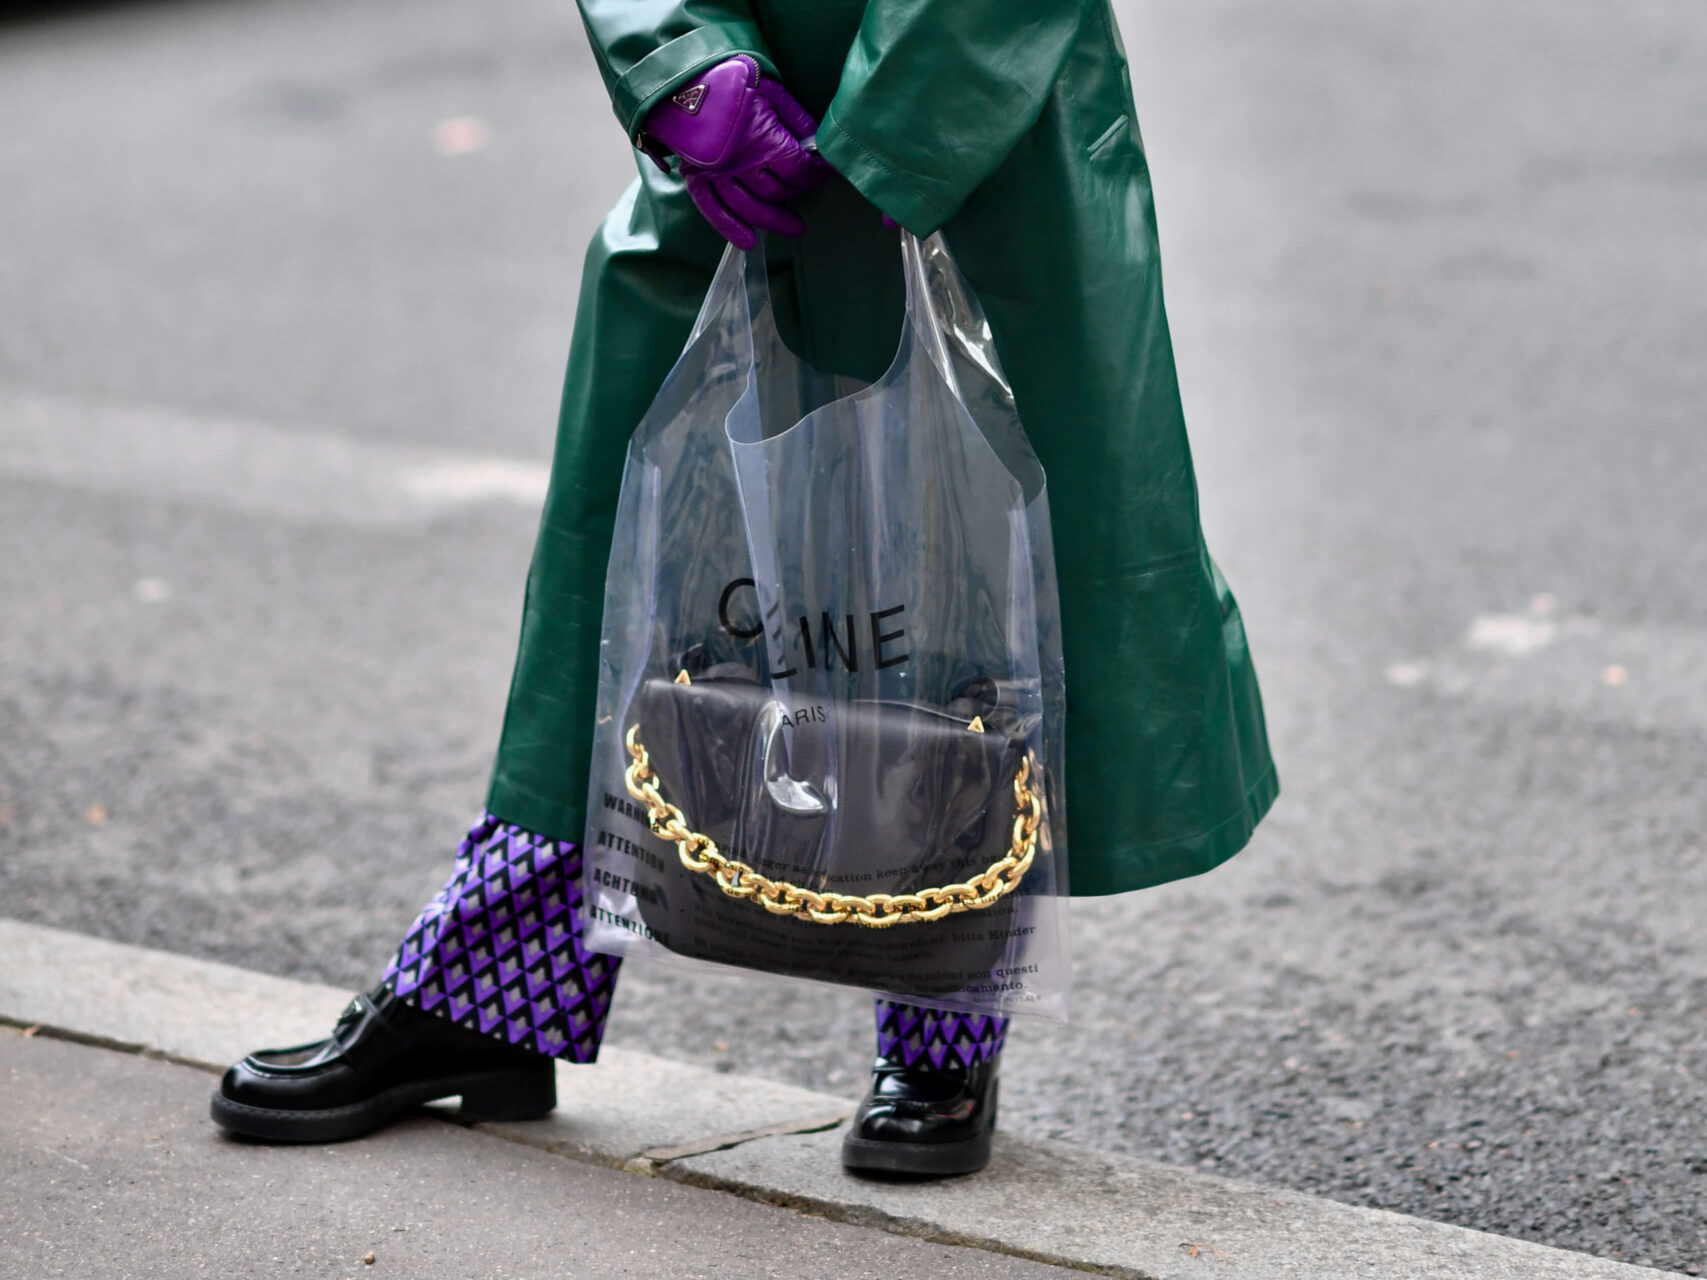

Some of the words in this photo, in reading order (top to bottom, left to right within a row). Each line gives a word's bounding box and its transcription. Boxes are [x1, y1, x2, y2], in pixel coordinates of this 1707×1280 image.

[718, 577, 910, 680] CINE
[779, 705, 827, 728] ARIS
[597, 830, 665, 874] ATTENTION
[876, 866, 908, 880] keep
[950, 855, 977, 870] this
[593, 868, 659, 905] ACHTUNG
[589, 904, 670, 946] ATTENZIONE
[989, 926, 1036, 941] Kinder
